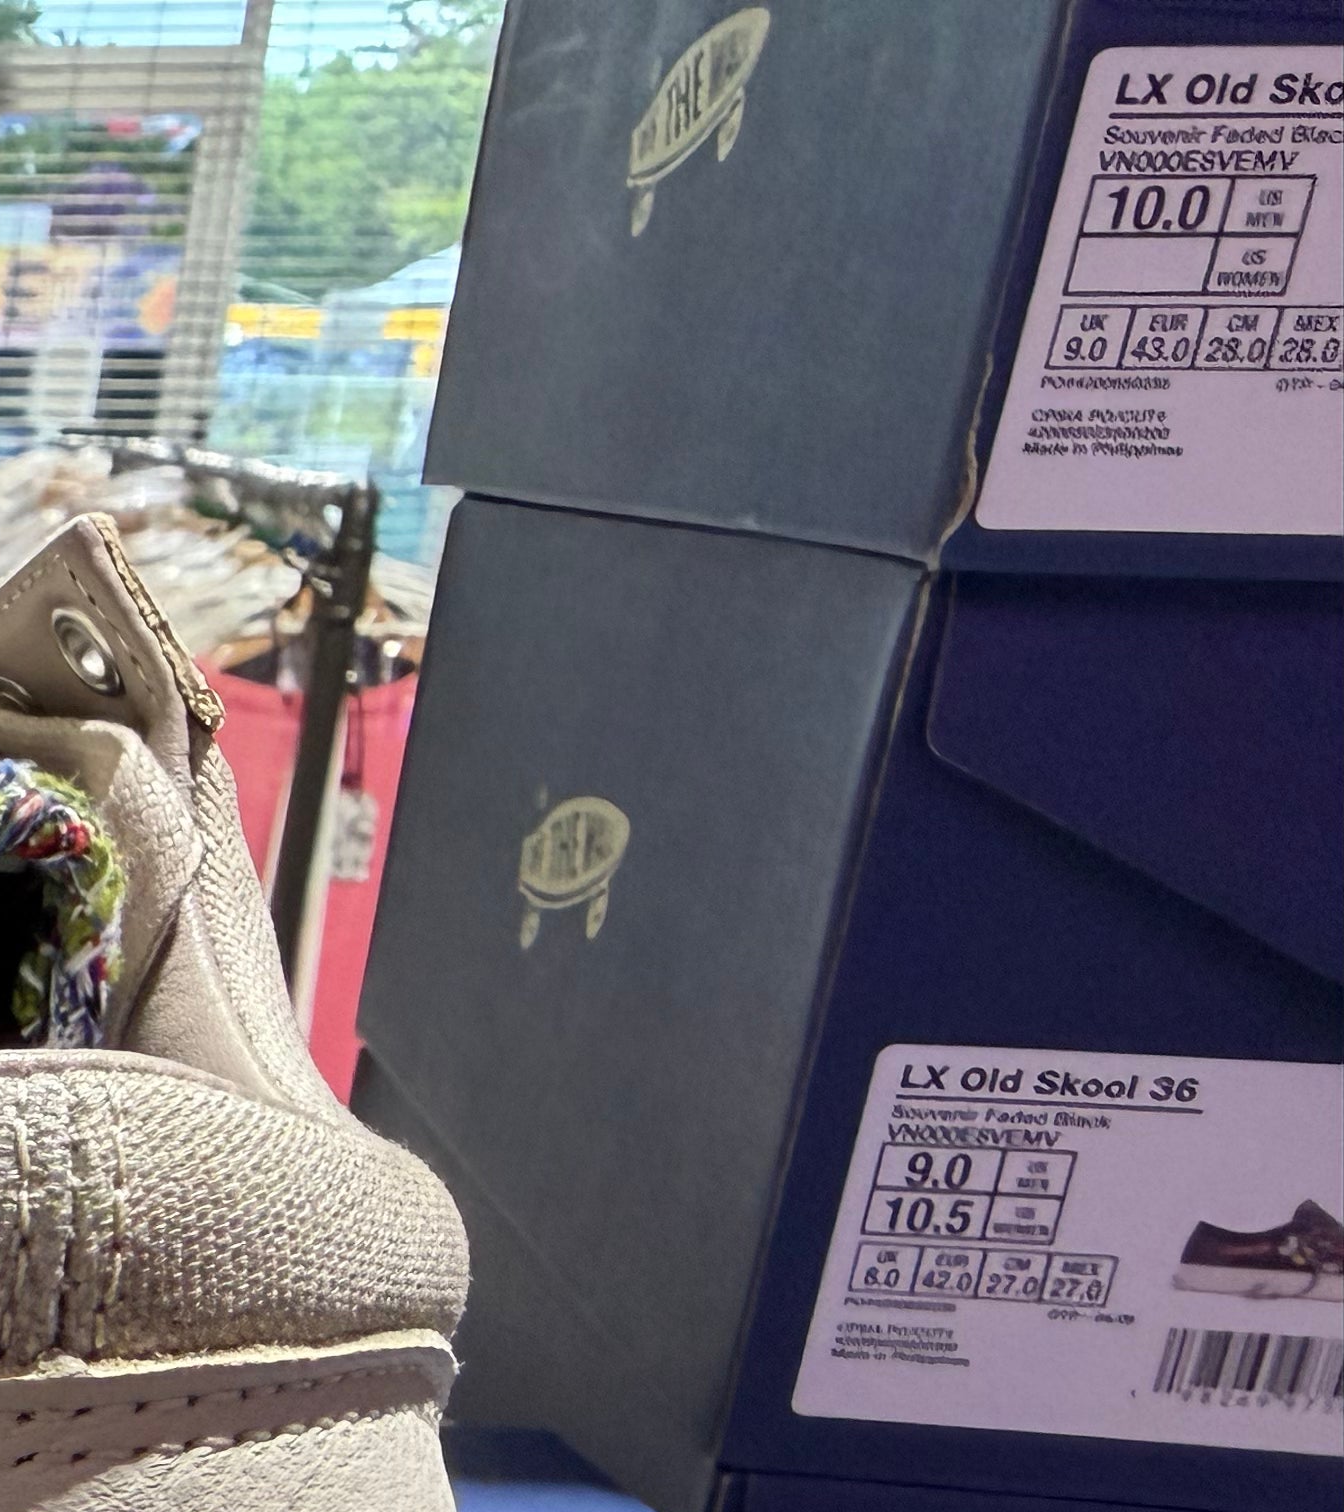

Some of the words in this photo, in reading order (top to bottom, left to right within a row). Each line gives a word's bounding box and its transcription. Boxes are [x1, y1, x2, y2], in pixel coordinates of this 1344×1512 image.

[1115, 72, 1174, 106] LX
[1185, 72, 1258, 106] Old
[1108, 184, 1210, 231] 10.0
[1079, 314, 1110, 332] UK
[1149, 314, 1190, 332] EUR
[1226, 314, 1260, 332] CM
[1063, 336, 1109, 362] 9.0
[1130, 336, 1190, 363] 43.0
[900, 1064, 951, 1090] LX
[961, 1067, 1024, 1094] Old
[1033, 1069, 1140, 1100] Skool
[1149, 1076, 1200, 1103] 36
[905, 1151, 973, 1190] 9.0
[886, 1197, 975, 1236] 10.5
